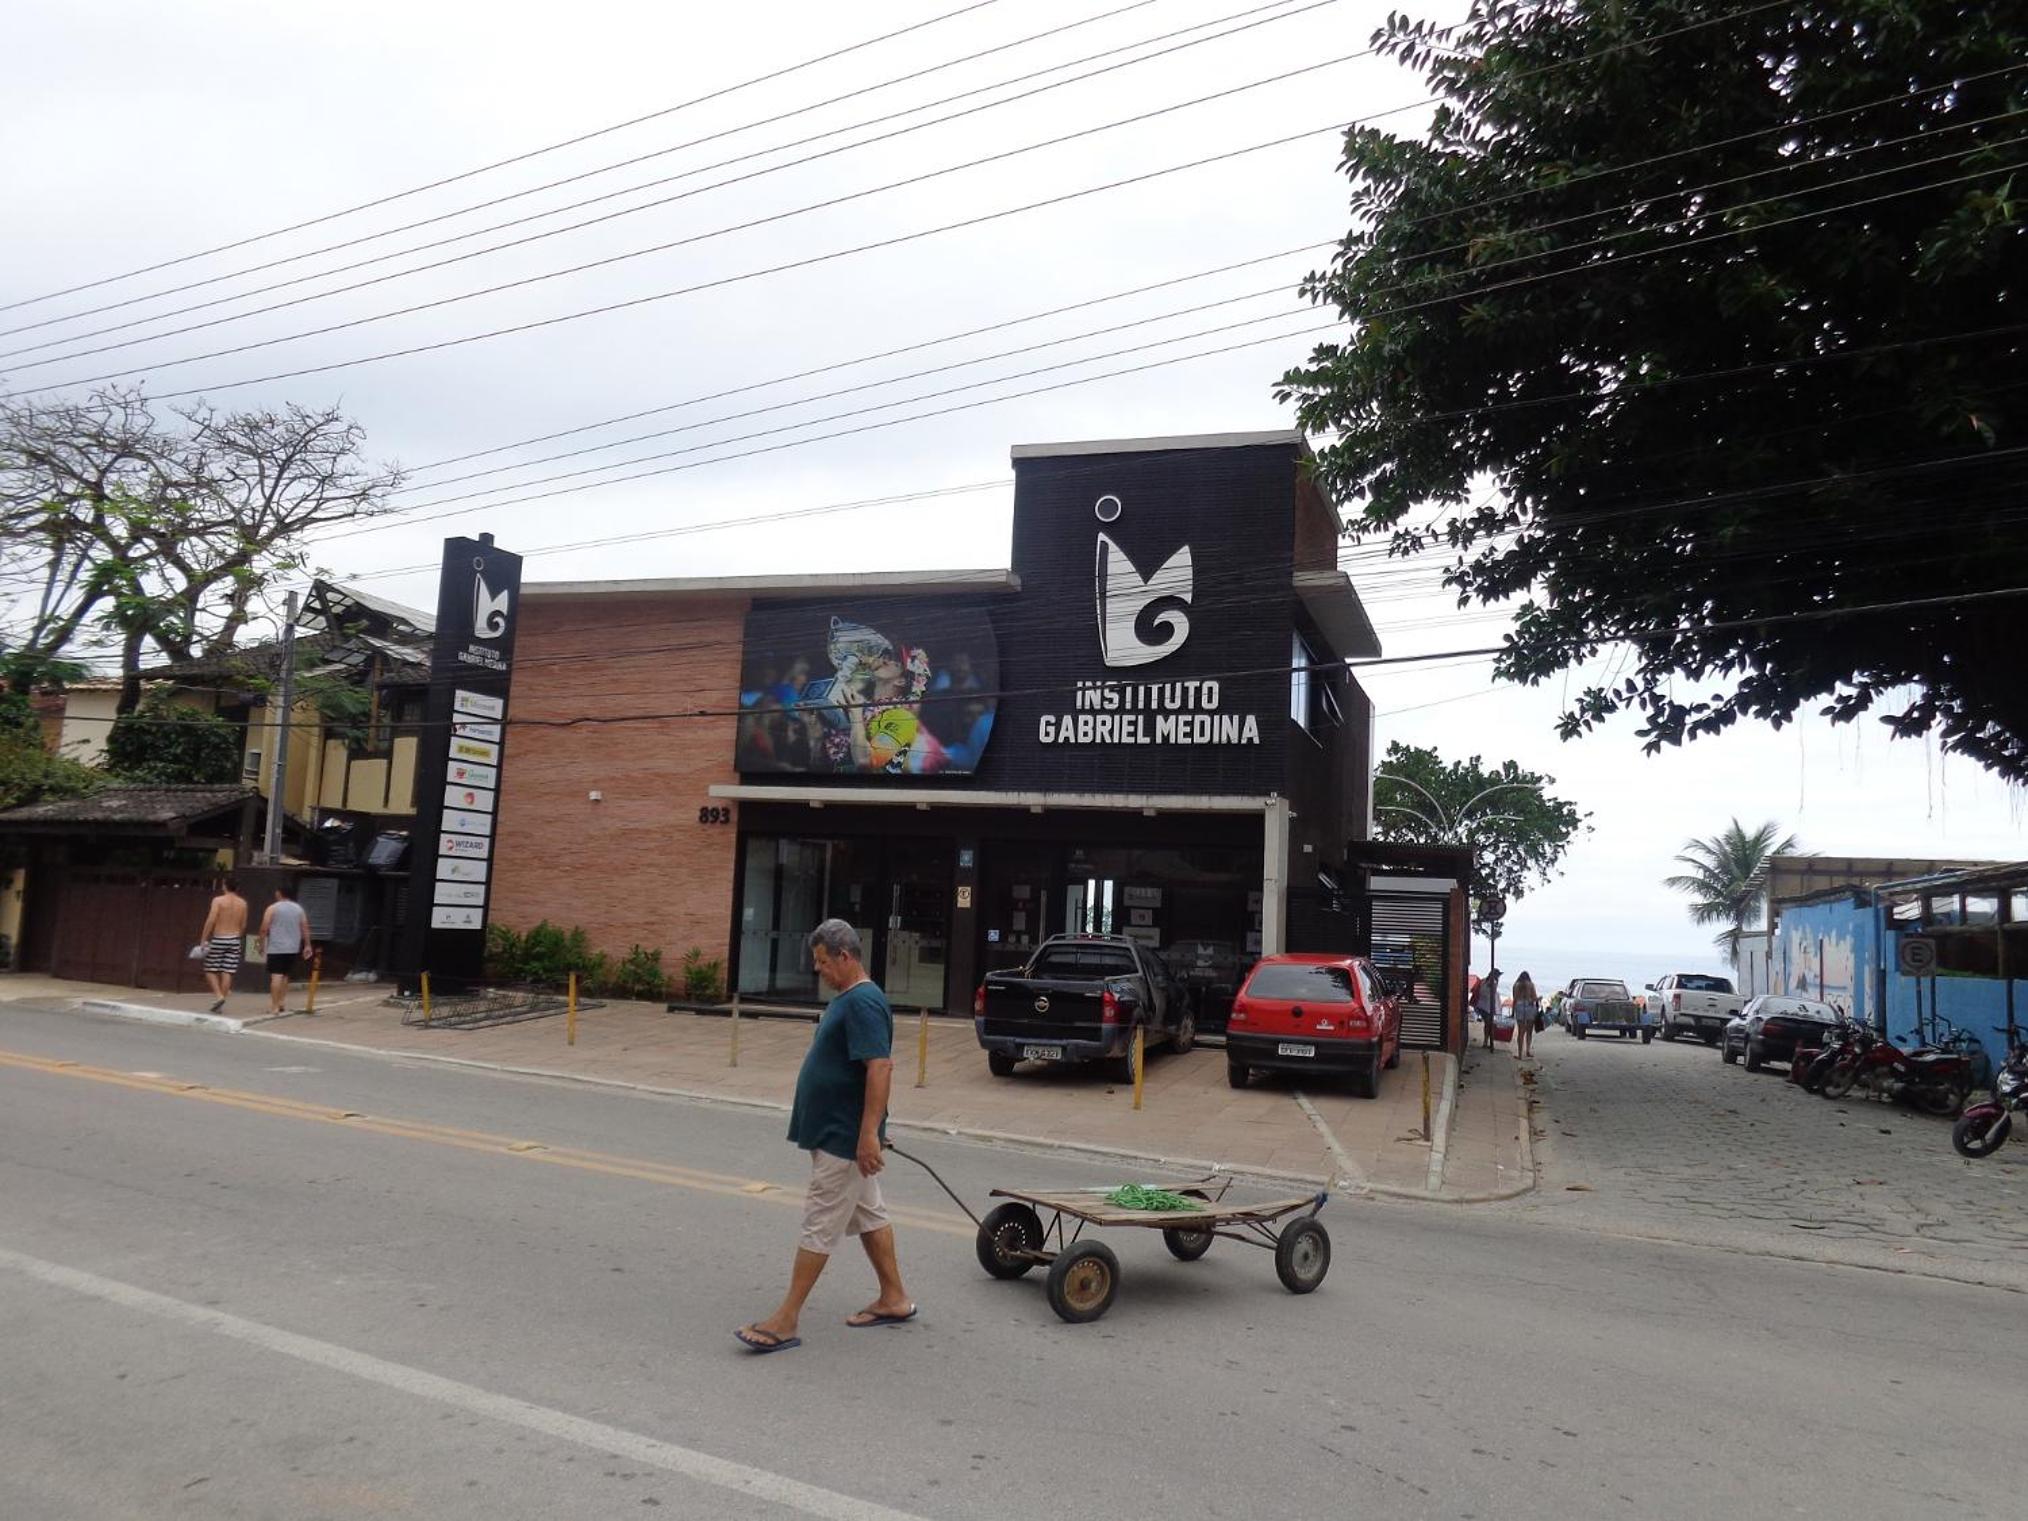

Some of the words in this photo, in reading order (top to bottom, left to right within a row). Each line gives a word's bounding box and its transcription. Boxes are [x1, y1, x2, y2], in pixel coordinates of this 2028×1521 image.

[1076, 680, 1220, 710] INSTITUTO
[1039, 714, 1151, 744] GABRIEL
[1155, 714, 1260, 745] MEDINA
[699, 806, 730, 824] 893
[455, 840, 484, 850] WIZARD
[1911, 946, 1923, 963] E
